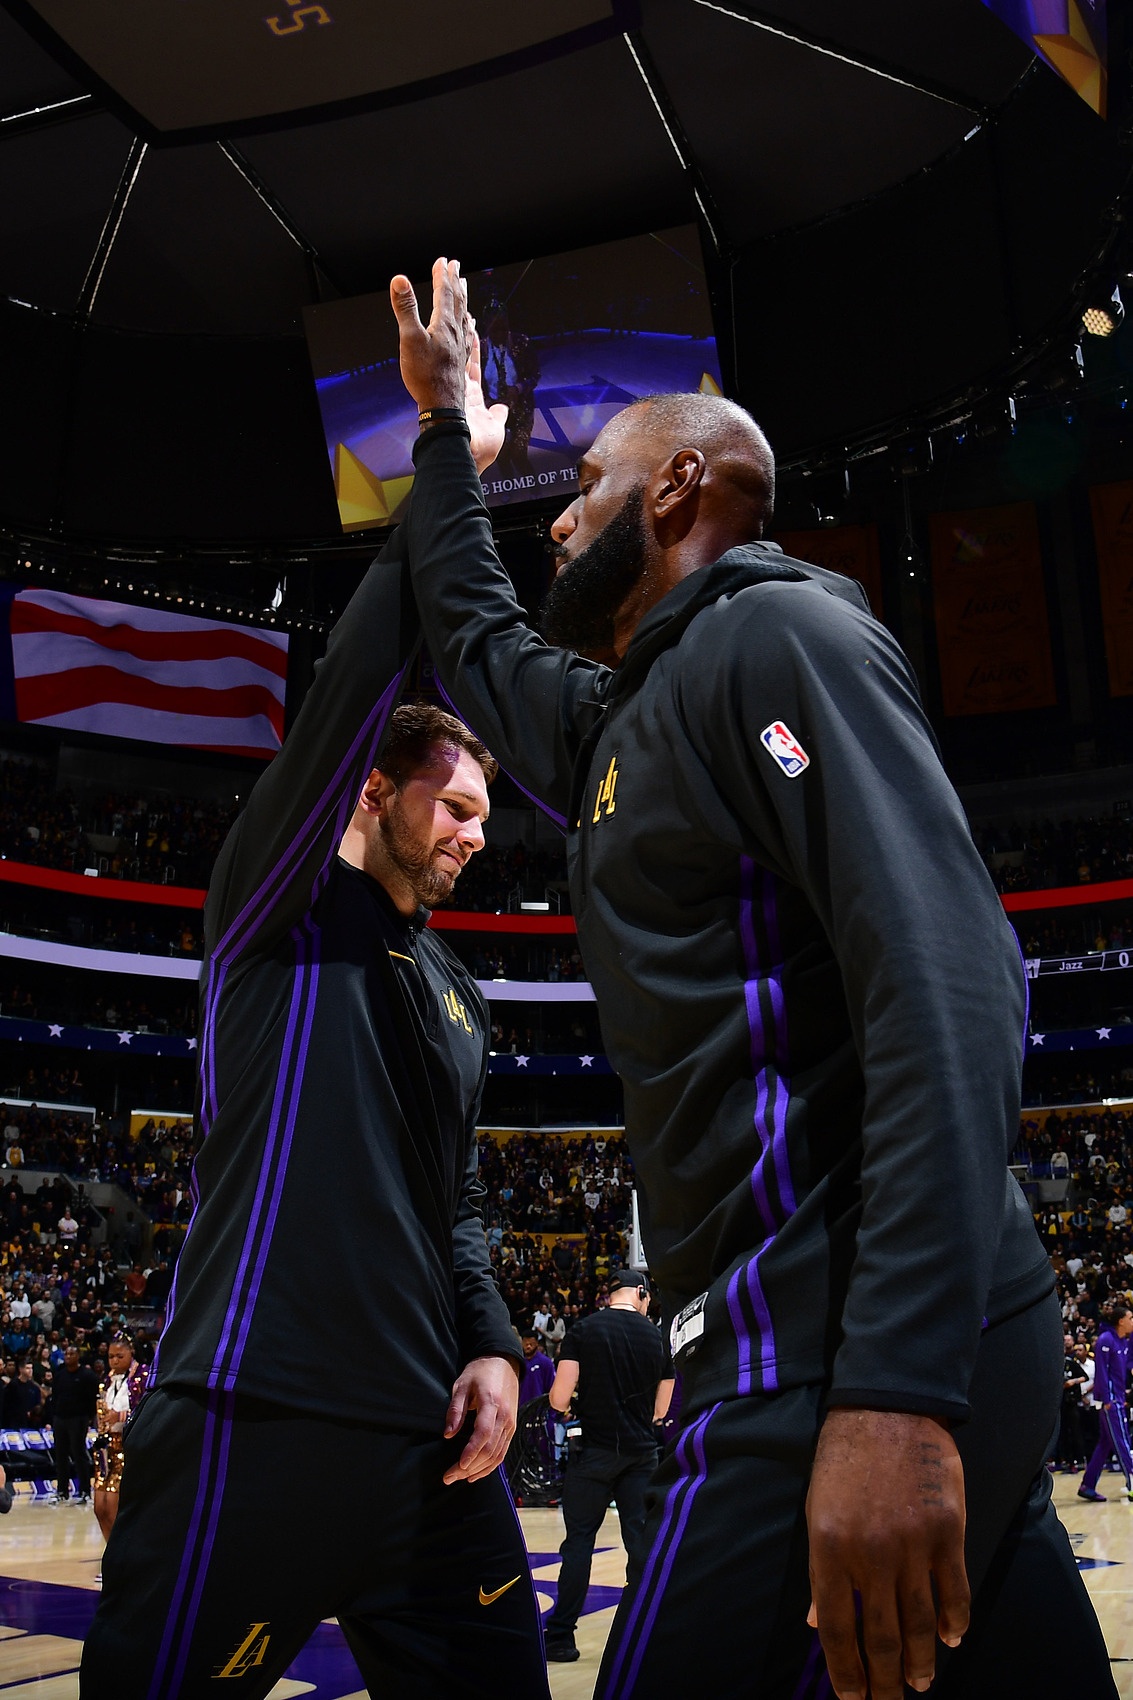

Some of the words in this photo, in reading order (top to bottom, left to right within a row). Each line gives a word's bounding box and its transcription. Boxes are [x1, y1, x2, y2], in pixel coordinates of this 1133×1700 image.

[492, 475, 536, 494] HOME
[538, 470, 558, 485] OF
[559, 466, 579, 481] TH
[1058, 961, 1083, 971] Jazz
[1118, 951, 1130, 967] 0
[211, 1621, 271, 1678] LA
